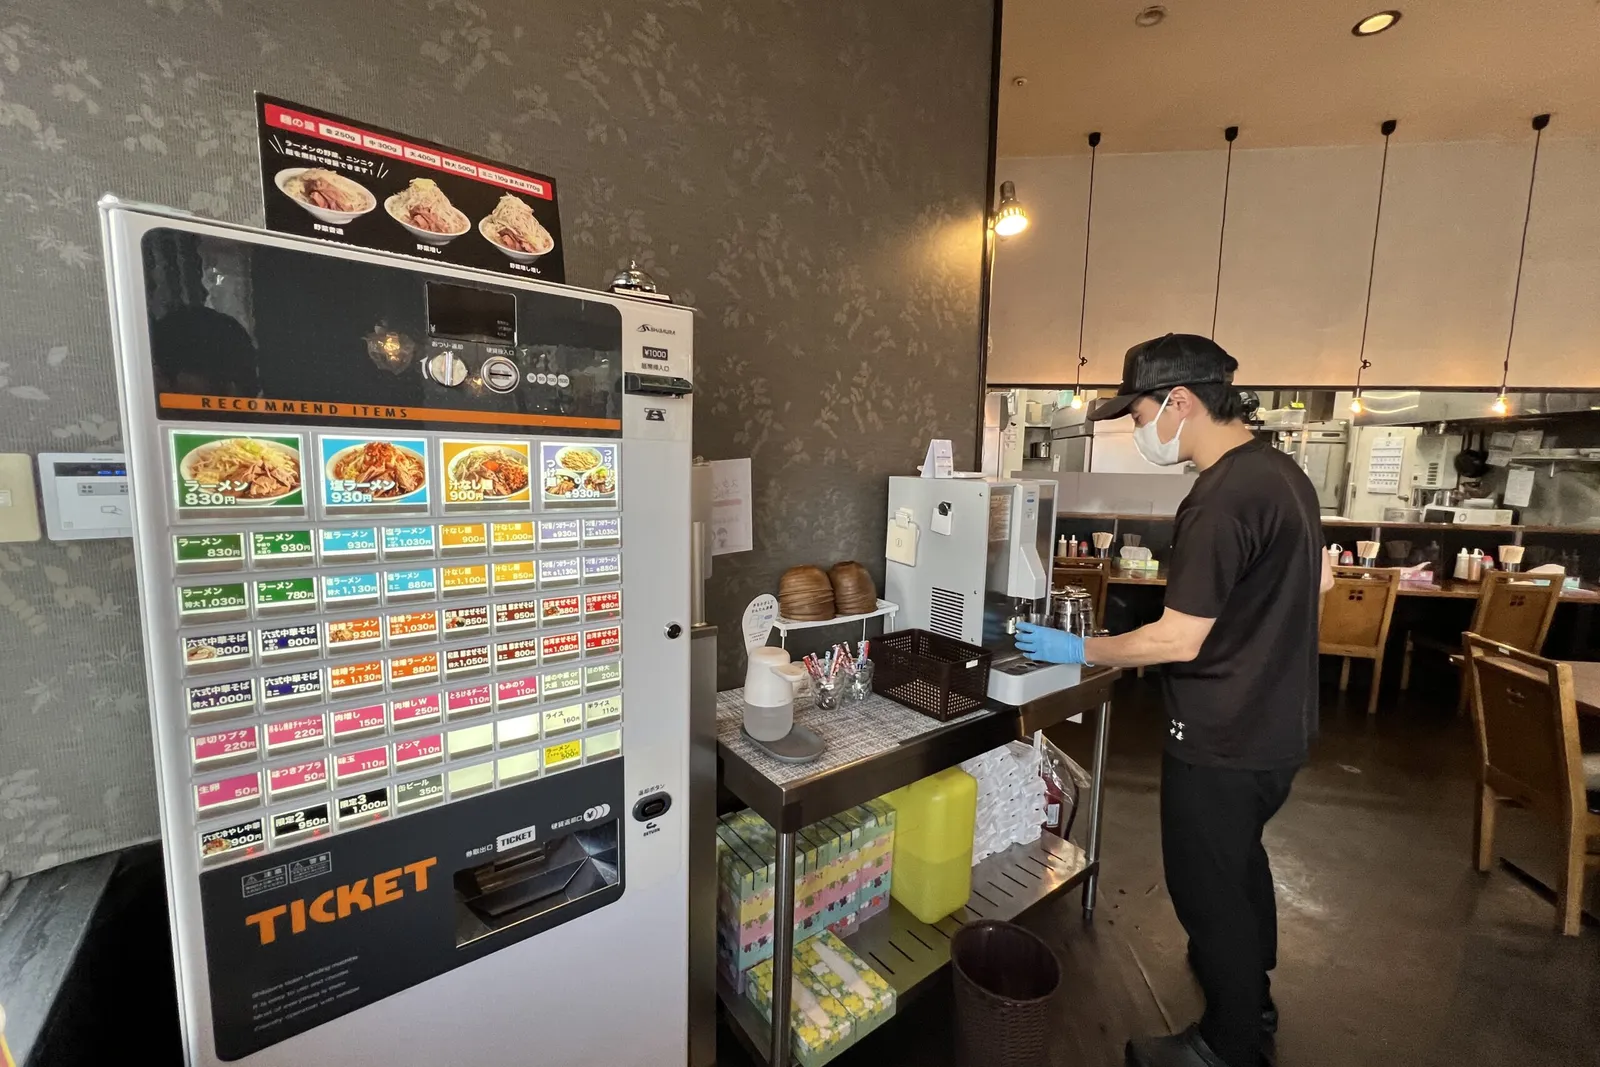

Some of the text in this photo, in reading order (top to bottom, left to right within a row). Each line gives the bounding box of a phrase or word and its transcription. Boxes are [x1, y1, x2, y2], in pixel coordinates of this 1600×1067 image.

[202, 398, 407, 418] RECOMMEND ITEMS
[184, 480, 248, 493] ラーメン
[185, 493, 235, 505] 830円
[331, 492, 372, 503] 930円
[450, 492, 484, 500] 900円
[179, 538, 221, 547] ラーメン
[255, 533, 294, 542] ラーメン
[400, 538, 431, 547] 1,030円
[281, 543, 311, 552] 930円
[347, 541, 375, 549] 930円
[207, 548, 240, 557] 830円
[259, 582, 294, 591] ラーメン
[408, 581, 433, 589] 880円
[183, 588, 222, 597] ラーメン
[286, 591, 314, 600] 780円
[262, 626, 316, 639] 六式中華そば
[404, 623, 435, 633] 1,030円
[352, 630, 379, 639] 930円
[288, 637, 317, 647] 900円
[216, 646, 248, 656] 800円
[412, 665, 436, 674] 880円
[350, 674, 381, 684] 1,130円
[191, 681, 249, 697] 六式中華そば
[292, 683, 320, 693] 750円
[499, 680, 525, 690] もみのり
[449, 686, 488, 700] とろけるチーズ
[516, 688, 535, 696] 110円
[415, 706, 438, 715] 250円
[545, 711, 564, 720] ライス
[359, 718, 383, 727] 150円
[563, 716, 580, 724] 160円
[294, 728, 322, 738] 220円
[224, 741, 255, 752] 220円
[397, 740, 420, 751] メンマ
[417, 746, 440, 755] 110円
[361, 760, 385, 770] 110円
[304, 772, 324, 781] 50円
[235, 787, 258, 797] 50円
[419, 785, 442, 796] 350円
[352, 800, 387, 813] 1,000円
[298, 818, 326, 830] 950円
[231, 833, 262, 846] 900円
[501, 831, 533, 847] TICKET
[245, 856, 437, 945] TICKET
